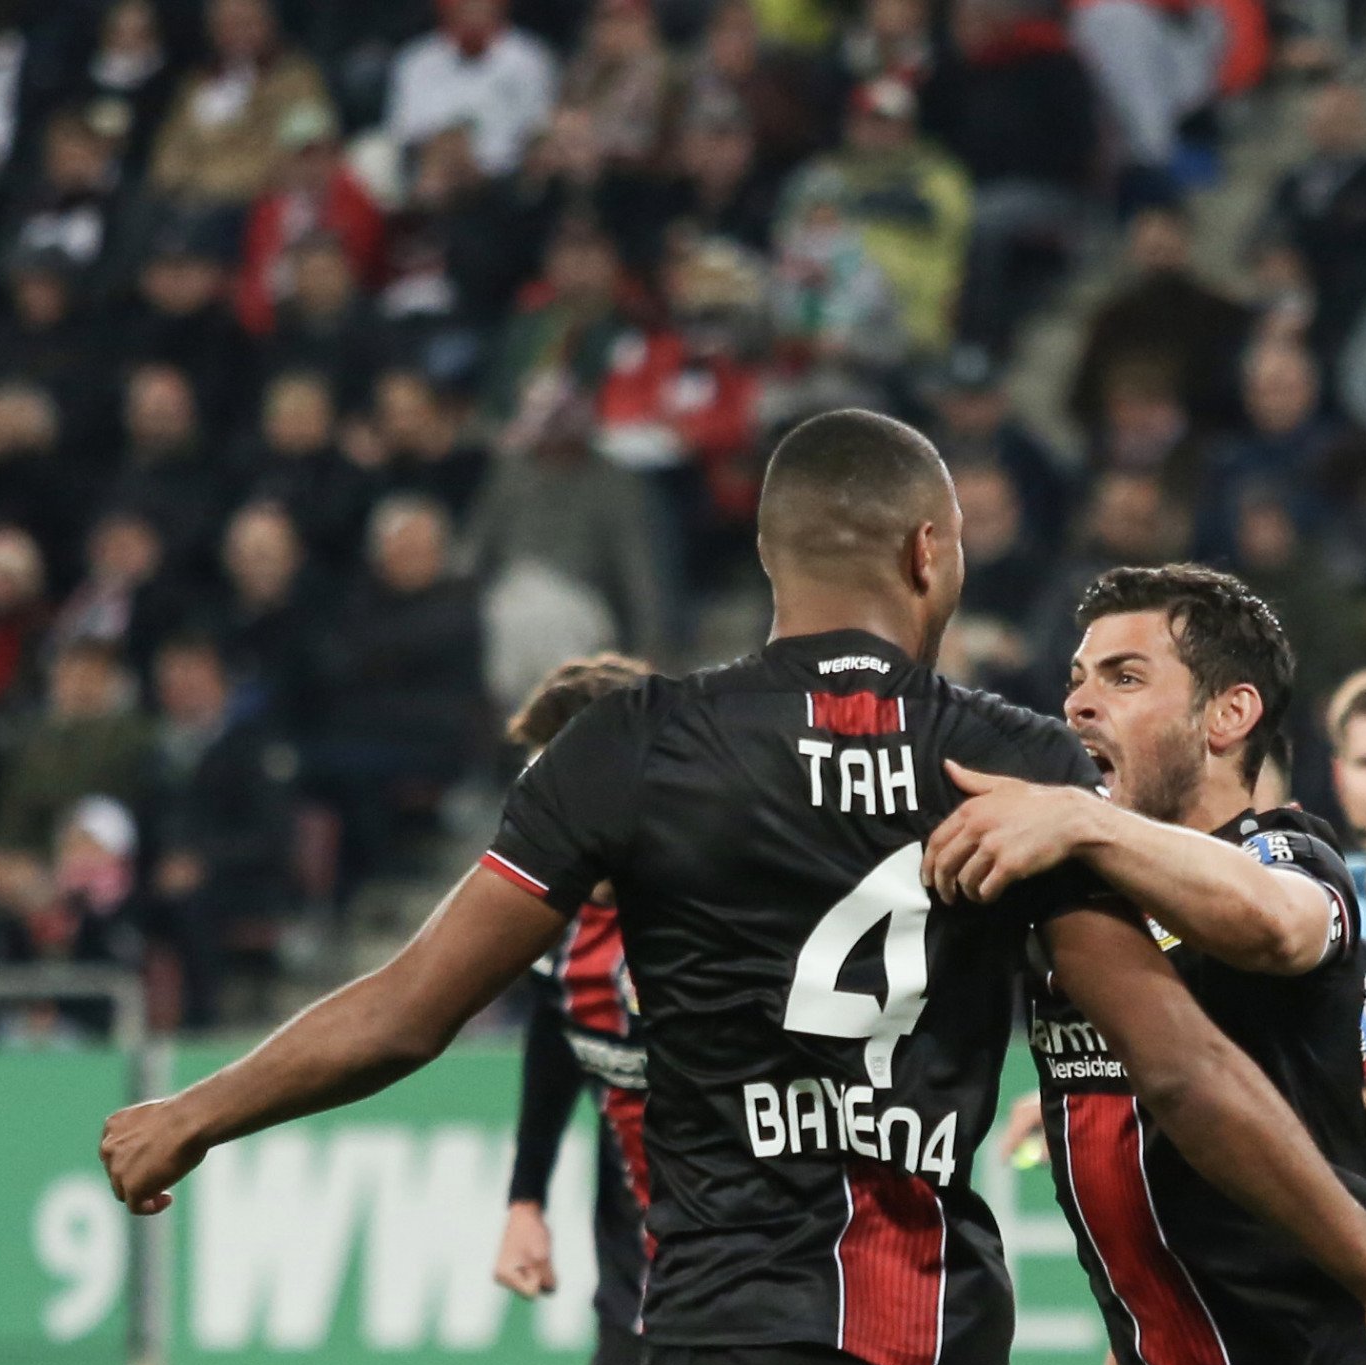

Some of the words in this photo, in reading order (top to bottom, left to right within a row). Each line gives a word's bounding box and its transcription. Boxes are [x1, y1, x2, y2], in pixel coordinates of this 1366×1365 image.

[818, 655, 891, 675] WERKSELF
[798, 739, 919, 815] TAH
[783, 840, 932, 1089] 4
[1031, 1019, 1108, 1054] arm
